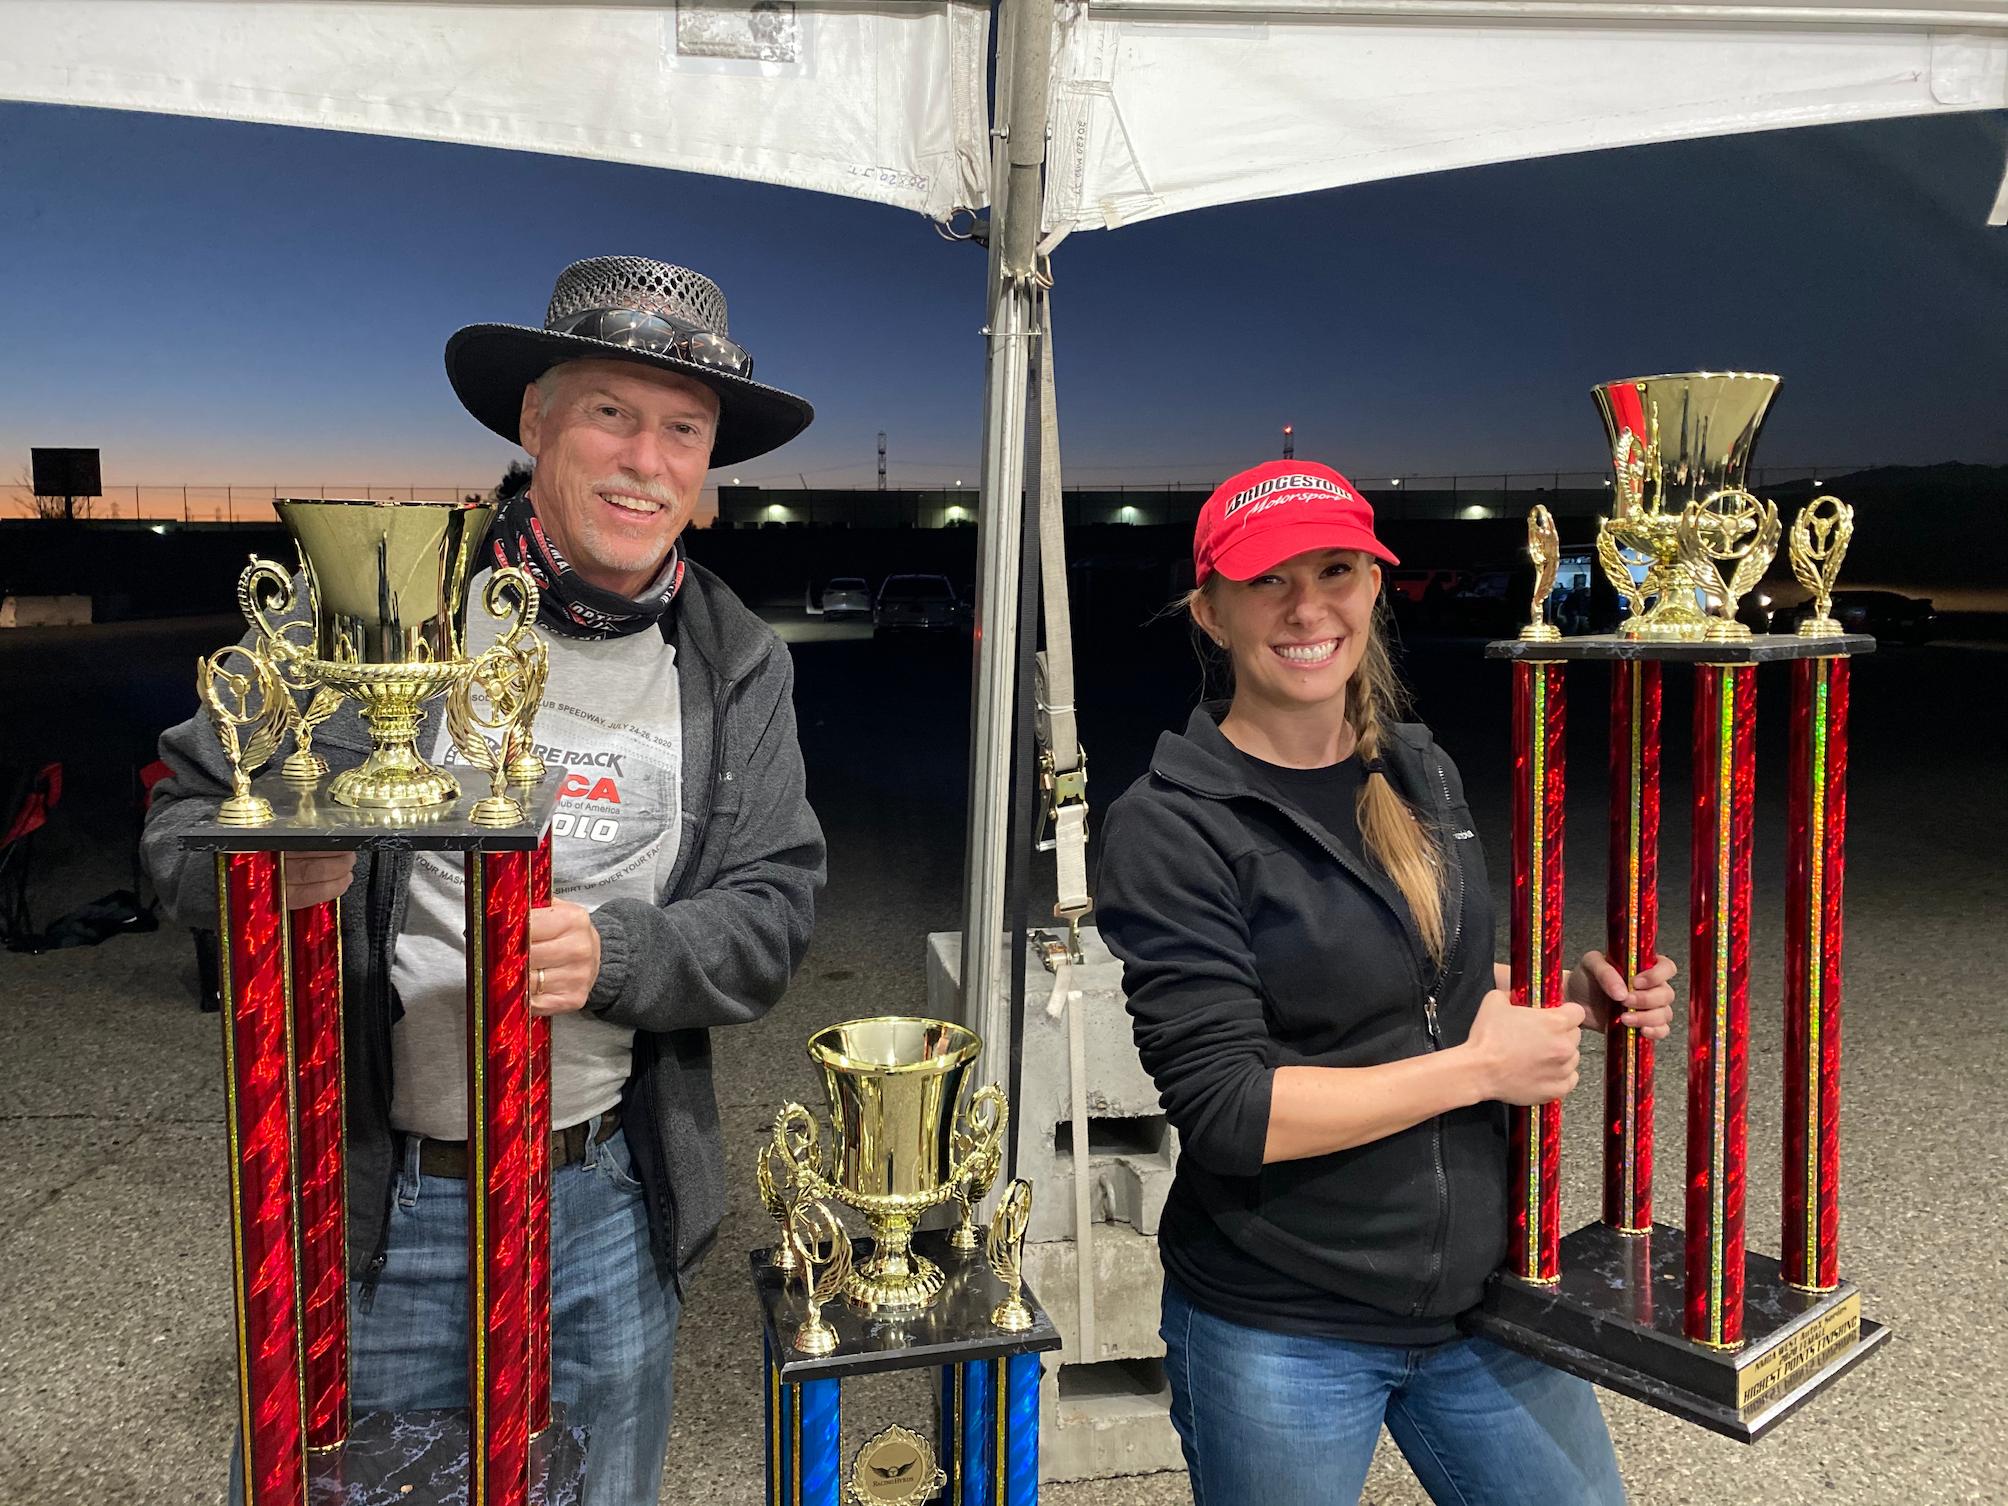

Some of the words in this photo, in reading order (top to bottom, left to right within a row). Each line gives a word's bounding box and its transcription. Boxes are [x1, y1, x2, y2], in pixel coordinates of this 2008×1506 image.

[538, 700, 555, 710] LUB
[557, 703, 606, 728] SPEEDWAY,
[608, 722, 628, 730] JULY
[653, 736, 673, 749] 2020
[556, 774, 621, 804] CA
[561, 800, 573, 809] ub
[575, 801, 584, 810] of
[585, 803, 620, 815] America
[416, 854, 440, 875] YOUR
[598, 871, 623, 887] OVER
[624, 855, 647, 874] YOUR
[1744, 1368, 1781, 1404] HIGHEST
[1784, 1346, 1815, 1375] POINTS
[1817, 1315, 1857, 1352] FINISHING
